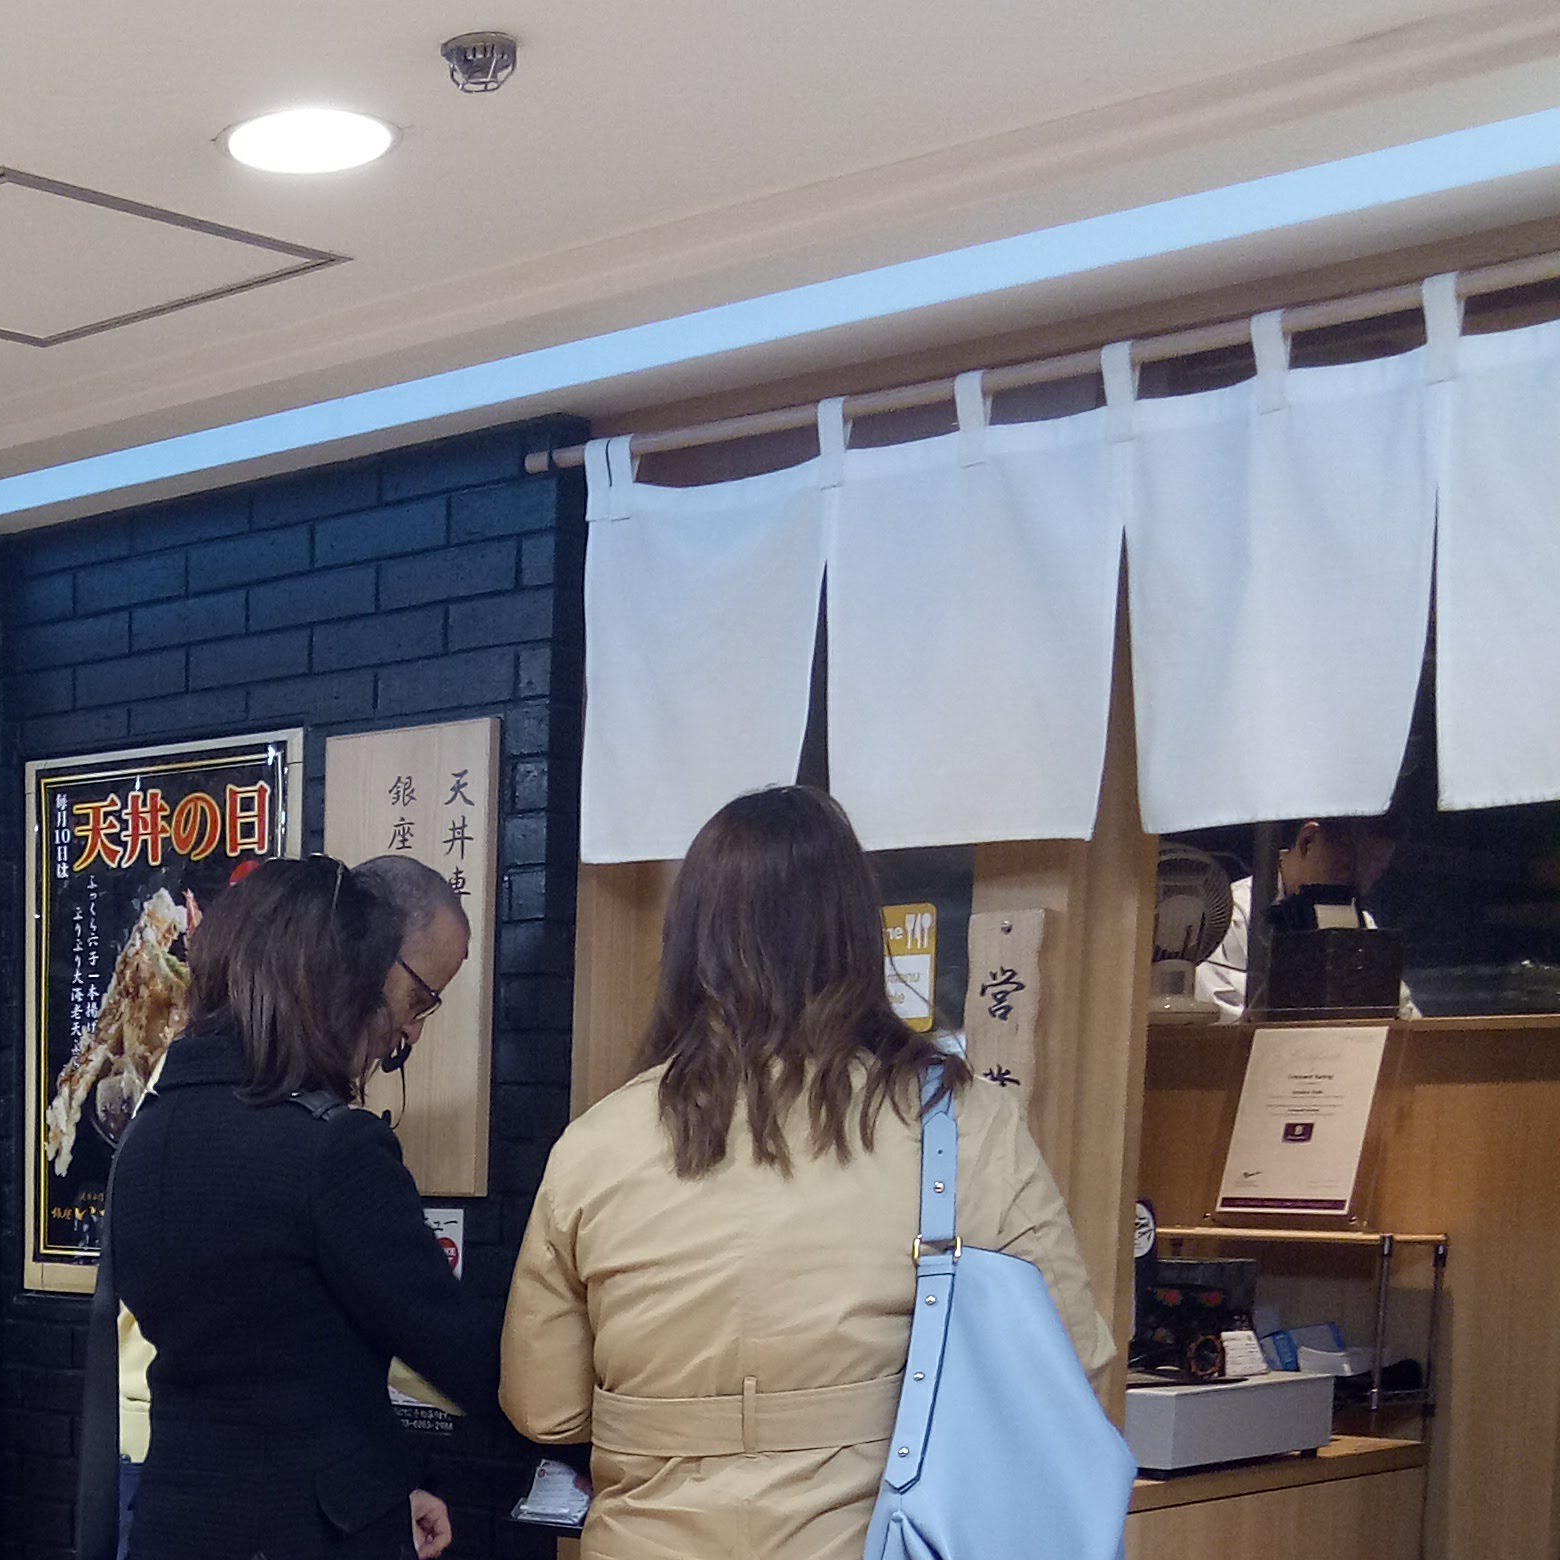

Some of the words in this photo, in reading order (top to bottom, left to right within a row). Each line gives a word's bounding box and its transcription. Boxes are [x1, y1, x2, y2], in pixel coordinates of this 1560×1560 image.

[54, 793, 71, 879] 毎月10日は
[73, 781, 271, 872] 天丼の日
[387, 775, 418, 850] 銀座
